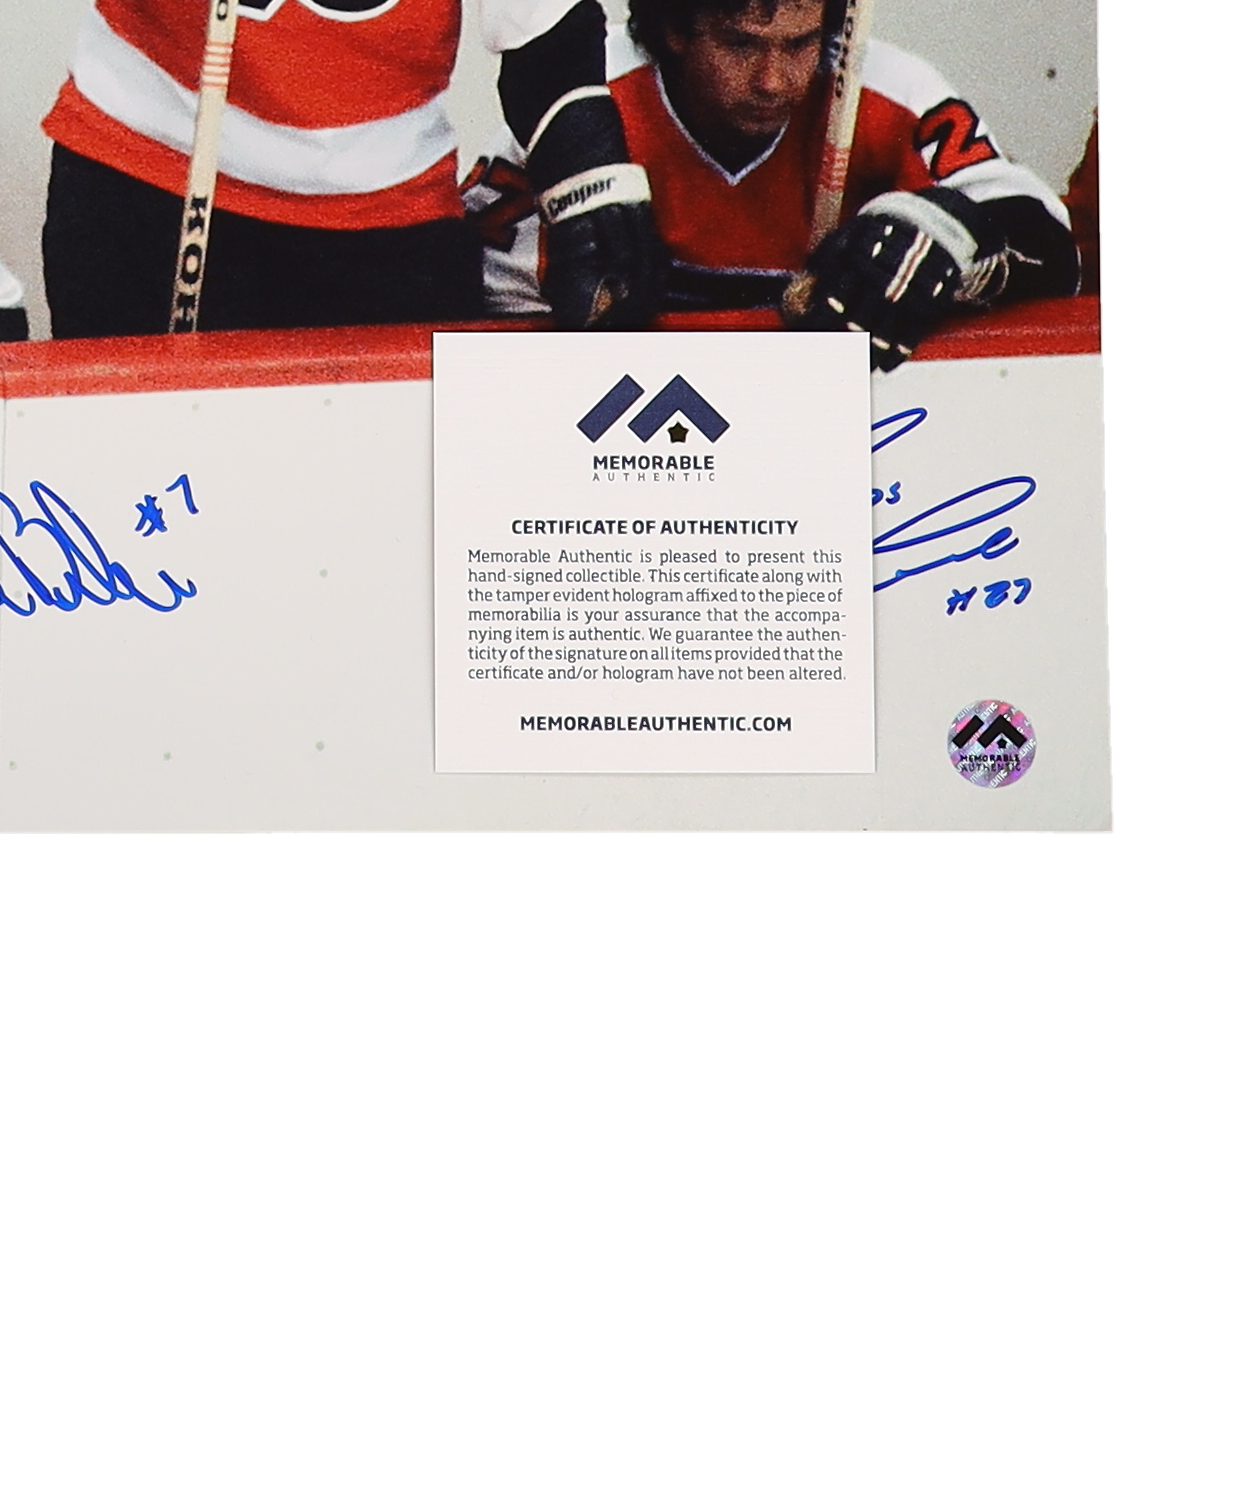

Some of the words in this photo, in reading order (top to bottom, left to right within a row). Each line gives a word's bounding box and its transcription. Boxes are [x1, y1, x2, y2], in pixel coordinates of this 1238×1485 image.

[547, 176, 617, 217] Cooper
[173, 195, 209, 332] KOH
[593, 455, 714, 470] MEMORABLE
[593, 473, 714, 481] AUTHENTIC
[512, 520, 627, 534] CERTIFICATE
[632, 520, 656, 534] OF
[660, 520, 798, 535] AUTHENTICITY
[468, 549, 550, 563] Memorable
[558, 549, 632, 563] Authentic
[640, 549, 652, 563] is
[660, 549, 717, 566] pleased
[725, 551, 740, 563] to
[748, 551, 805, 566] present
[813, 549, 842, 563] this
[468, 568, 563, 585] hand-signed
[566, 569, 644, 582] collectible.
[648, 569, 680, 582] This
[684, 569, 759, 583] certificate
[762, 569, 803, 586] along
[807, 569, 842, 583] with
[468, 588, 492, 601] the
[496, 589, 550, 605] tamper
[553, 588, 609, 602] evident
[613, 588, 683, 605] hologram
[686, 588, 737, 602] affixed
[740, 590, 755, 602] to
[758, 588, 783, 602] the
[786, 588, 825, 605] piece
[828, 588, 842, 602] of
[469, 607, 561, 621] memorabilia
[567, 607, 578, 621] is
[584, 611, 619, 624] your
[625, 611, 701, 621] assurance
[707, 608, 738, 621] that
[744, 608, 769, 621] the
[775, 611, 846, 625] accompa-
[469, 627, 512, 644] nying
[516, 627, 549, 640] item
[553, 627, 564, 640] is
[569, 627, 644, 641] authentic.
[649, 627, 671, 641] We
[676, 629, 753, 644] guarantee
[757, 627, 782, 641] the
[787, 627, 846, 641] authen-
[468, 646, 507, 663] ticity
[510, 646, 525, 660] of
[528, 646, 553, 660] the
[555, 646, 627, 663] signature
[630, 650, 648, 660] on
[651, 646, 668, 660] all
[671, 647, 712, 660] items
[715, 647, 780, 663] provided
[783, 647, 814, 660] that
[817, 647, 842, 660] the
[468, 665, 543, 679] certificate
[548, 666, 598, 679] and/or
[602, 666, 673, 683] hologram
[678, 666, 714, 680] have
[718, 667, 743, 680] not
[747, 666, 784, 680] been
[789, 666, 846, 680] altered.
[521, 716, 791, 731] MEMORABLEAUTHENTIC.COM
